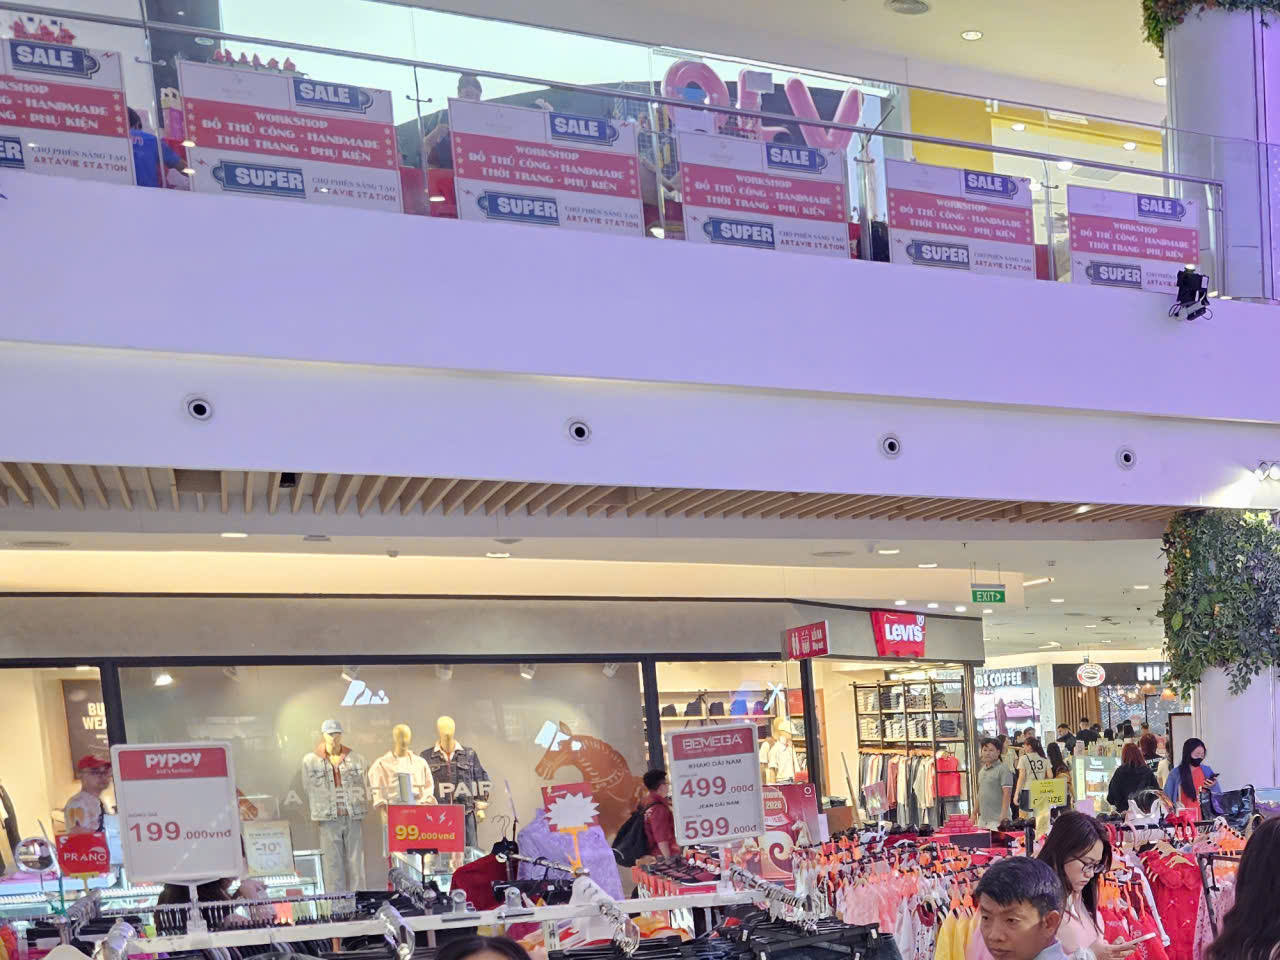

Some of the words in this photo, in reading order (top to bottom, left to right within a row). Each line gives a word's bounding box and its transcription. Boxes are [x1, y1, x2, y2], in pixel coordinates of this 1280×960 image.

[16, 46, 74, 68] SALE
[300, 83, 350, 103] SALE
[26, 98, 108, 115] HANDMADE
[30, 113, 61, 126] PHỤ
[66, 116, 98, 130] KIỆN
[255, 112, 328, 129] WORKSHOP
[555, 118, 599, 136] SALE
[259, 124, 295, 139] CÔNG
[307, 133, 380, 149] HANDMADE
[256, 139, 299, 153] TRANG
[311, 146, 338, 160] PHỤ
[342, 149, 371, 162] KIỆN
[516, 145, 579, 160] WORKSHOP
[770, 148, 809, 166] SALE
[34, 156, 79, 167] ARTAVIE
[83, 161, 127, 172] STATION
[519, 158, 550, 170] CÔNG
[560, 165, 625, 180] HANDMADE
[235, 167, 303, 190] SUPER
[514, 171, 553, 184] TRANG
[736, 174, 792, 189] WORKSHOP
[967, 174, 1002, 191] SALE
[357, 192, 396, 202] STATION
[936, 199, 986, 212] WORKSHOP
[498, 197, 558, 218] SUPER
[1141, 198, 1172, 214] SALE
[605, 219, 639, 229] STATION
[720, 223, 774, 243] SUPER
[922, 245, 968, 263] SUPER
[1100, 266, 1141, 282] SUPER
[976, 592, 995, 601] EXIT
[989, 671, 1022, 686] COFFEE
[682, 734, 743, 750] BEMEGA
[145, 751, 202, 769] pypoy
